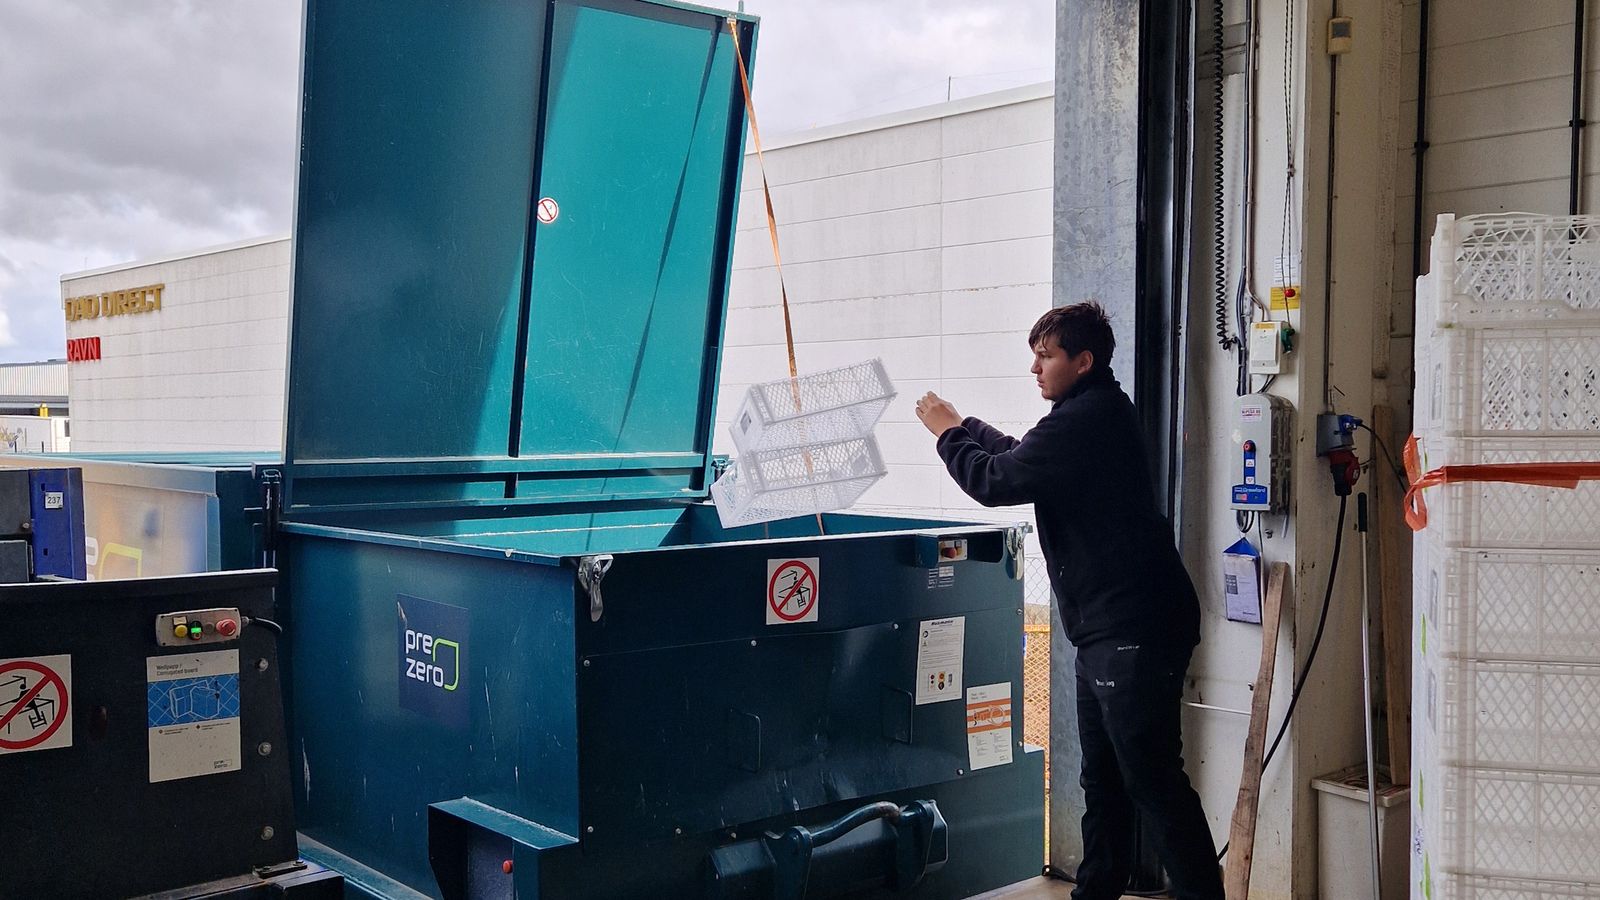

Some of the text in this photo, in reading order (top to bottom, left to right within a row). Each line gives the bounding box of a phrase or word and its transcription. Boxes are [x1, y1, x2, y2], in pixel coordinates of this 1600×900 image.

[101, 284, 164, 317] DIRECT
[67, 337, 100, 361] RAVN
[47, 496, 61, 504] 237
[405, 629, 433, 654] pre
[406, 657, 444, 687] zero
